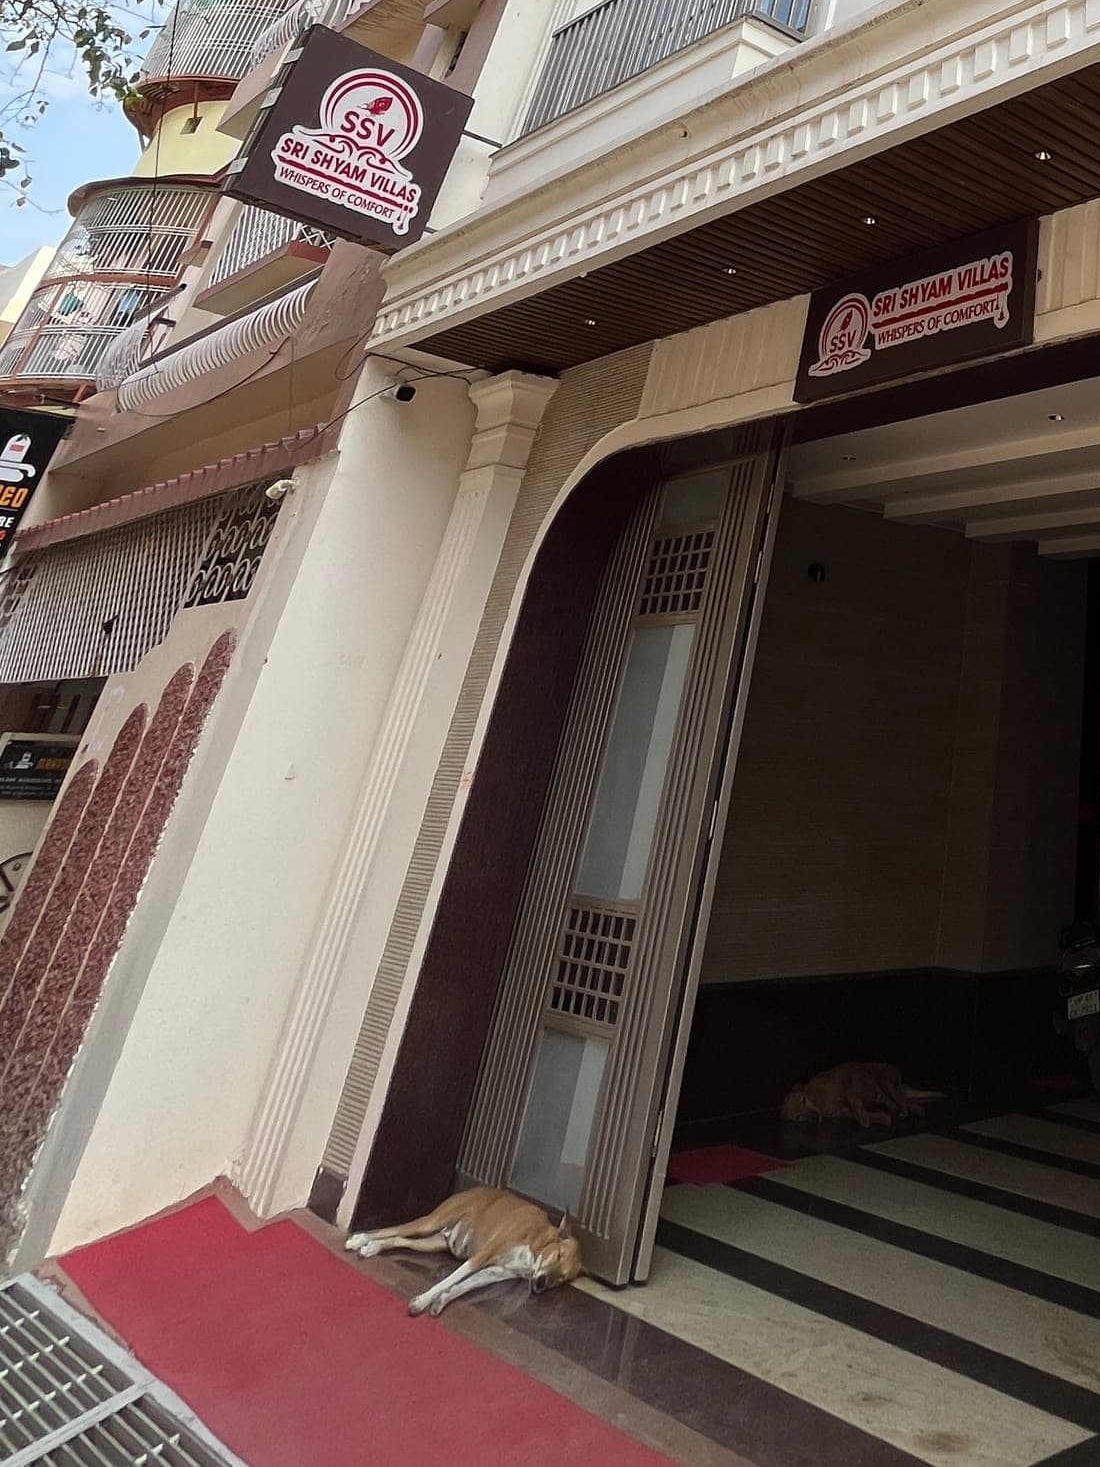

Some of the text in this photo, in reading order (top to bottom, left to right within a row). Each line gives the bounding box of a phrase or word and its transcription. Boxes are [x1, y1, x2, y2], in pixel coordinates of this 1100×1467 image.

[340, 110, 396, 147] SSV
[279, 167, 396, 219] WHISPERS OF COMFORT
[281, 138, 418, 203] SRI SHYAM VILLAS
[873, 256, 1010, 318] SRI SHYAM VILLAS
[829, 329, 857, 354] SSV
[877, 299, 998, 345] WHISPERS OF COMFORT
